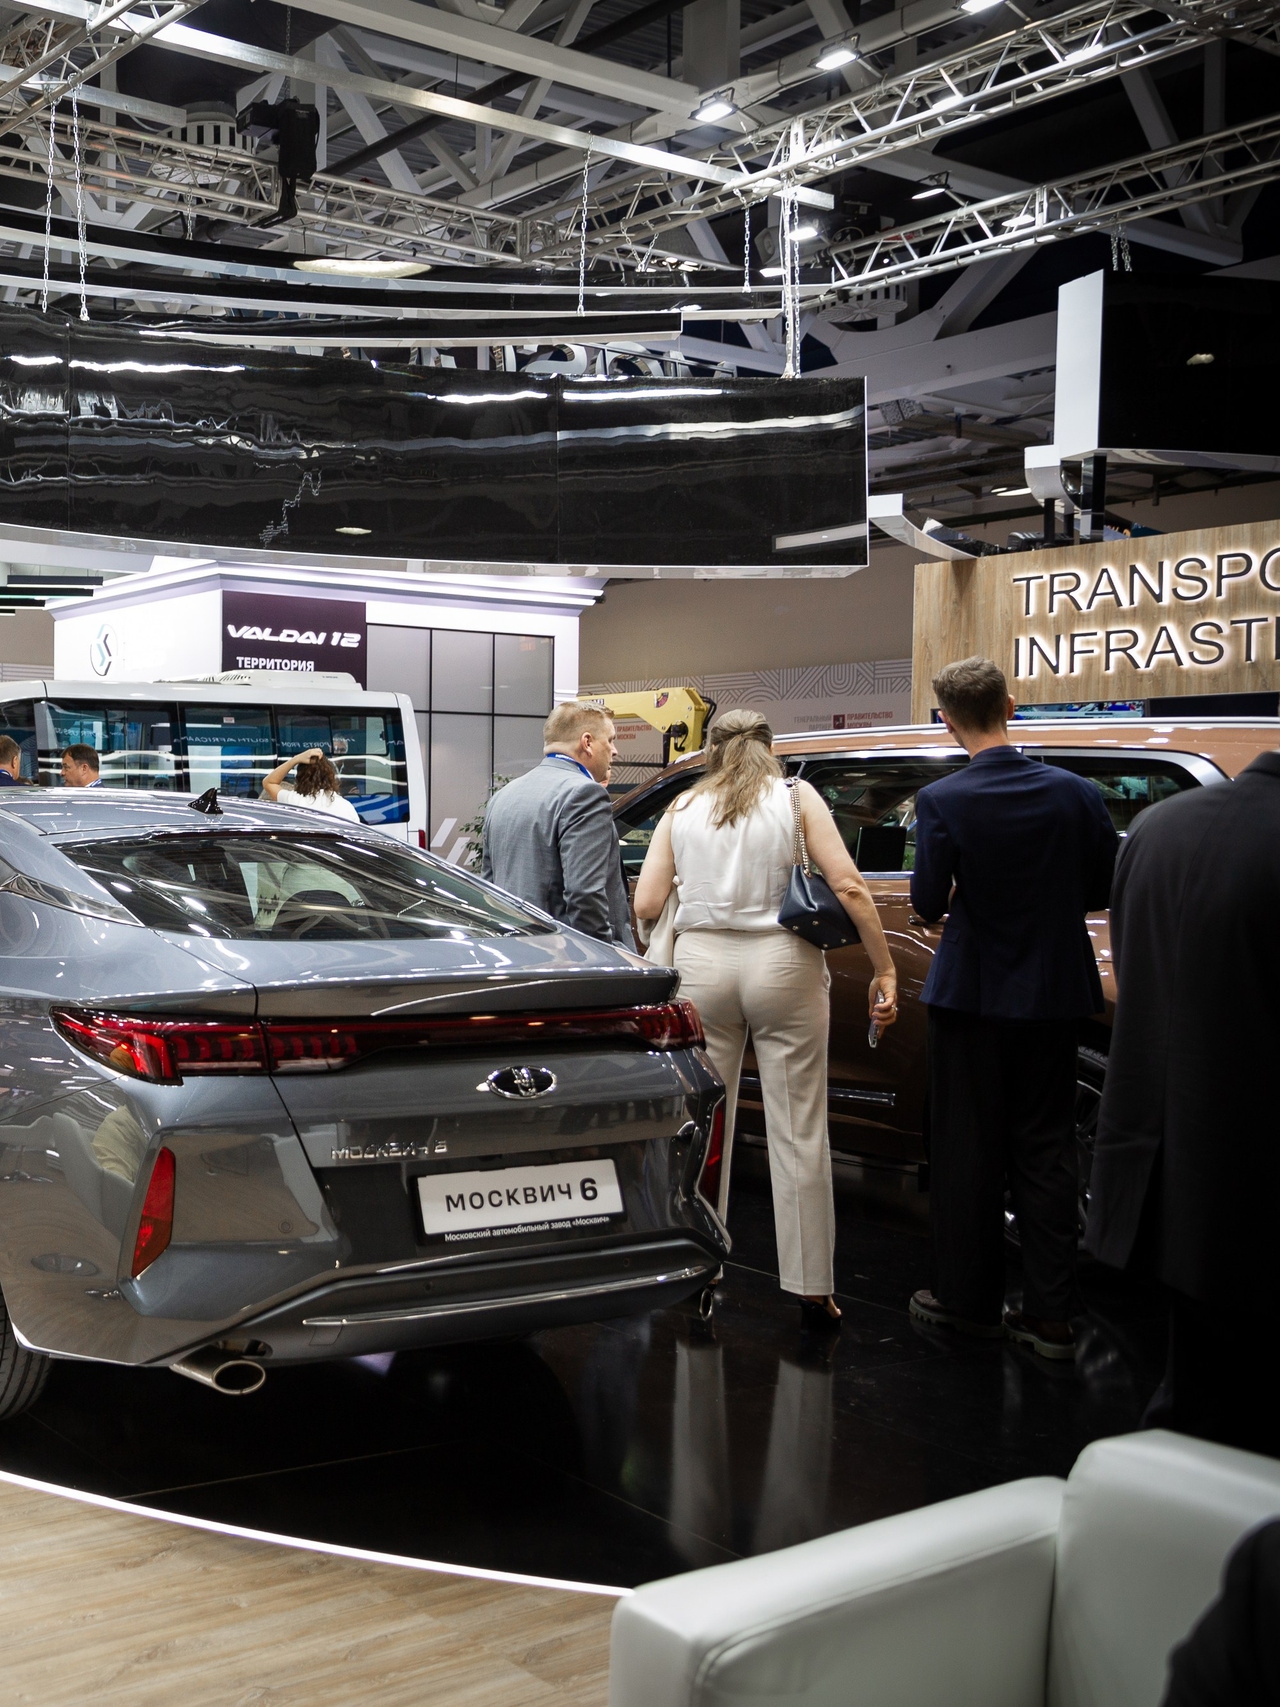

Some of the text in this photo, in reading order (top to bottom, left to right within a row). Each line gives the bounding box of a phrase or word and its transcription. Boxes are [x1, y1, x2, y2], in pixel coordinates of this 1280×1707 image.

[227, 624, 362, 648] VALDAI 12
[1014, 616, 1280, 678] INFRAST
[236, 656, 315, 672] ТЕРРИТОРИЯ
[445, 1177, 599, 1213] МОСКВИЧ 6
[445, 1216, 610, 1242] Московский автомобильный завод «Москвич»
